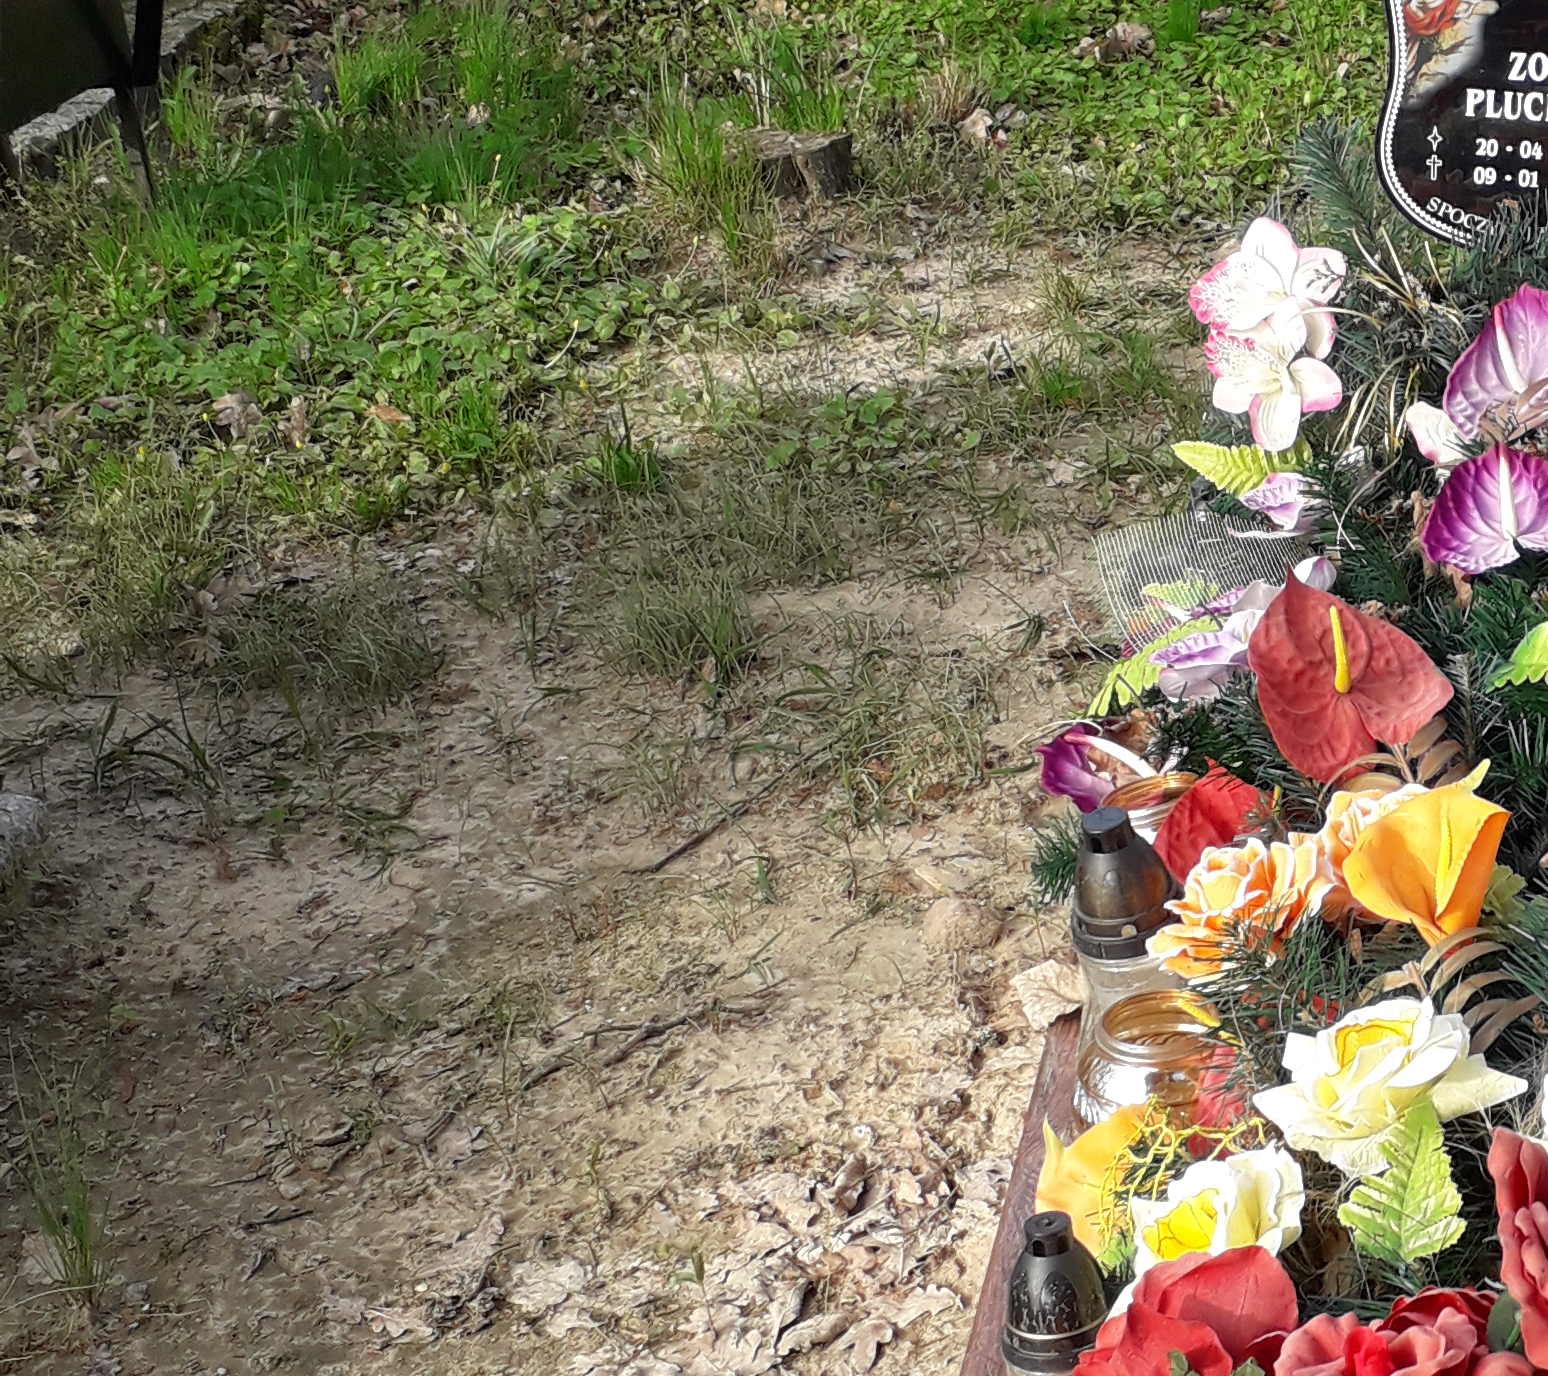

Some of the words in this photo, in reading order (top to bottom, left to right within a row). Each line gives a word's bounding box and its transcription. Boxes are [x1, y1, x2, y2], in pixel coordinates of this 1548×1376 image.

[1475, 138, 1499, 158] 20
[1519, 140, 1544, 162] 04
[1473, 166, 1497, 186] 09
[1517, 168, 1540, 189] 01
